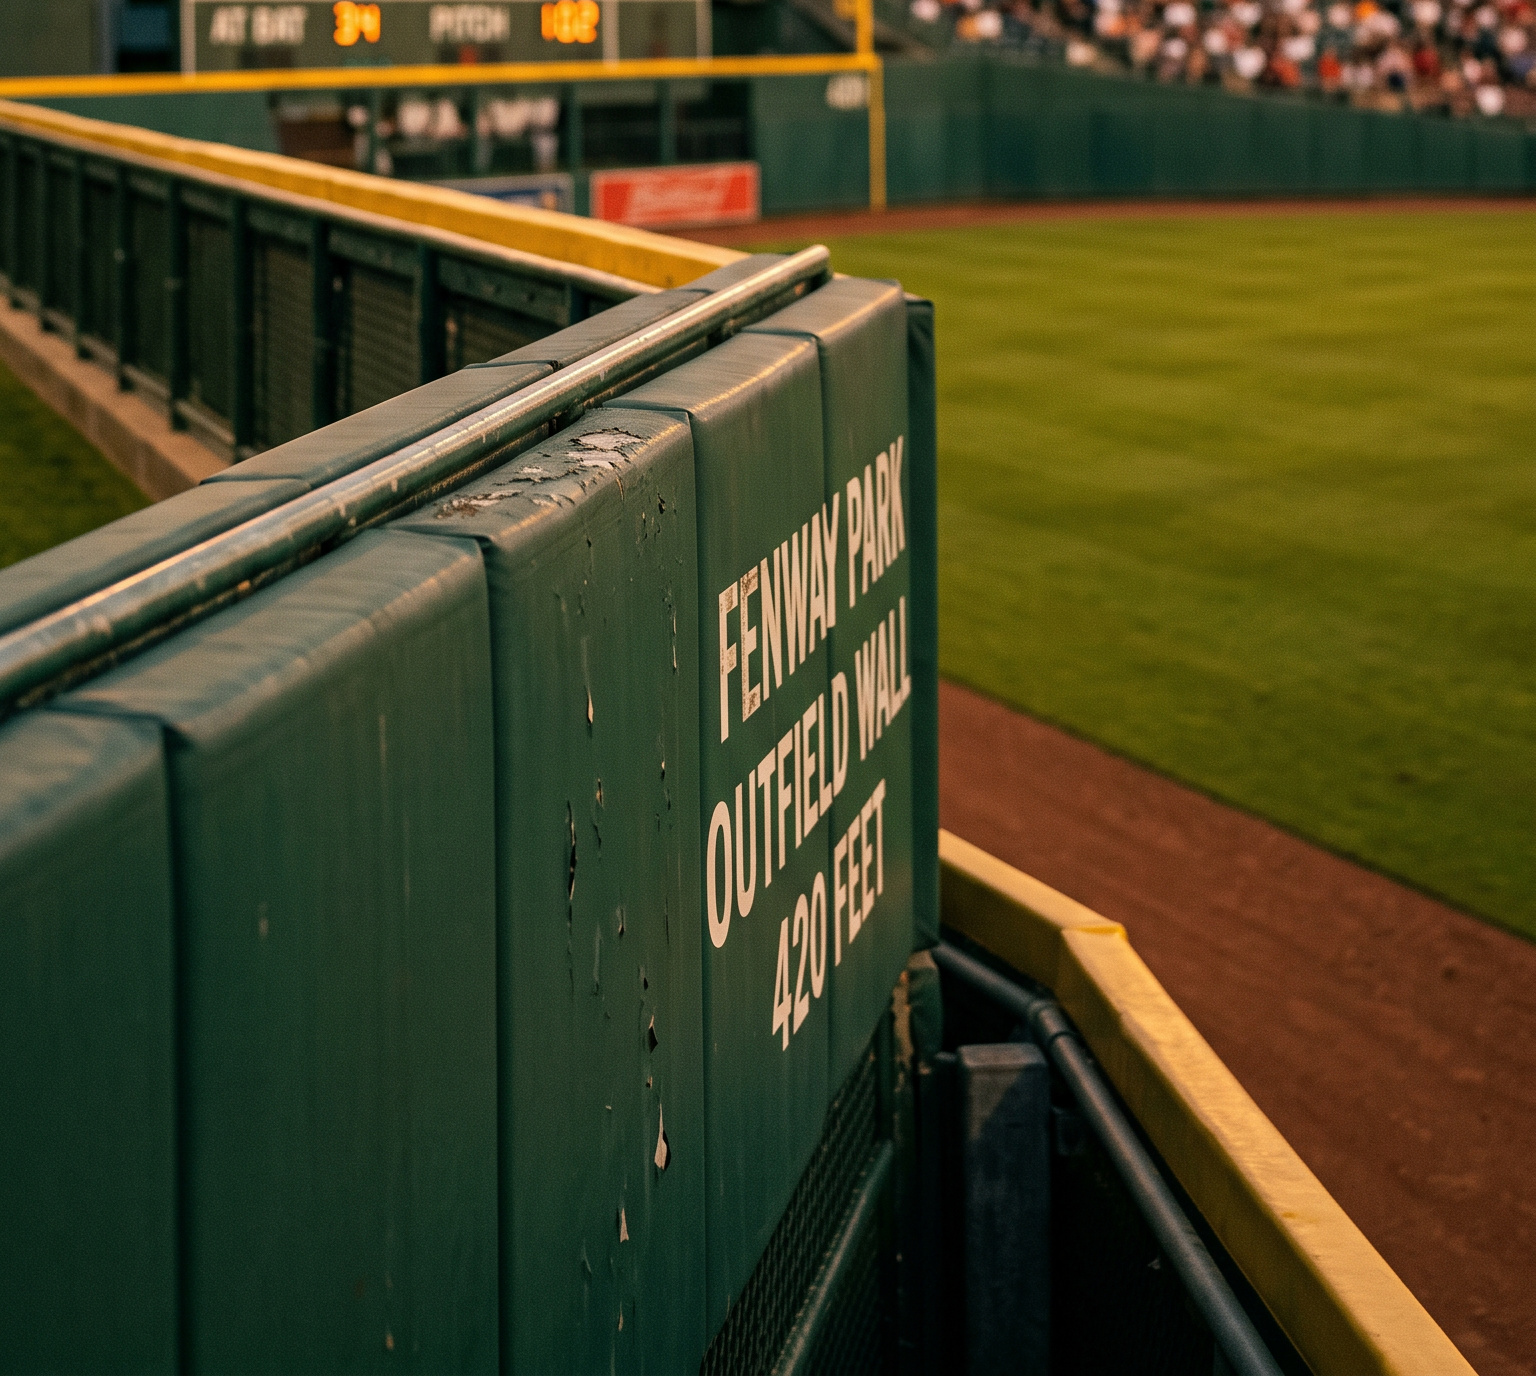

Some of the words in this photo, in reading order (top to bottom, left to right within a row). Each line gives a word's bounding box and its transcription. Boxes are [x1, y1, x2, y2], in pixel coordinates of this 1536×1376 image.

[210, 5, 246, 45] AT
[252, 5, 308, 45] BAT
[429, 4, 510, 43] PITCH
[718, 492, 841, 743] FENWAY
[847, 434, 906, 608] PARK
[706, 670, 850, 949] OUTFIELD
[855, 595, 912, 761] WALL
[771, 871, 828, 1052] 420
[834, 778, 887, 967] FEET
